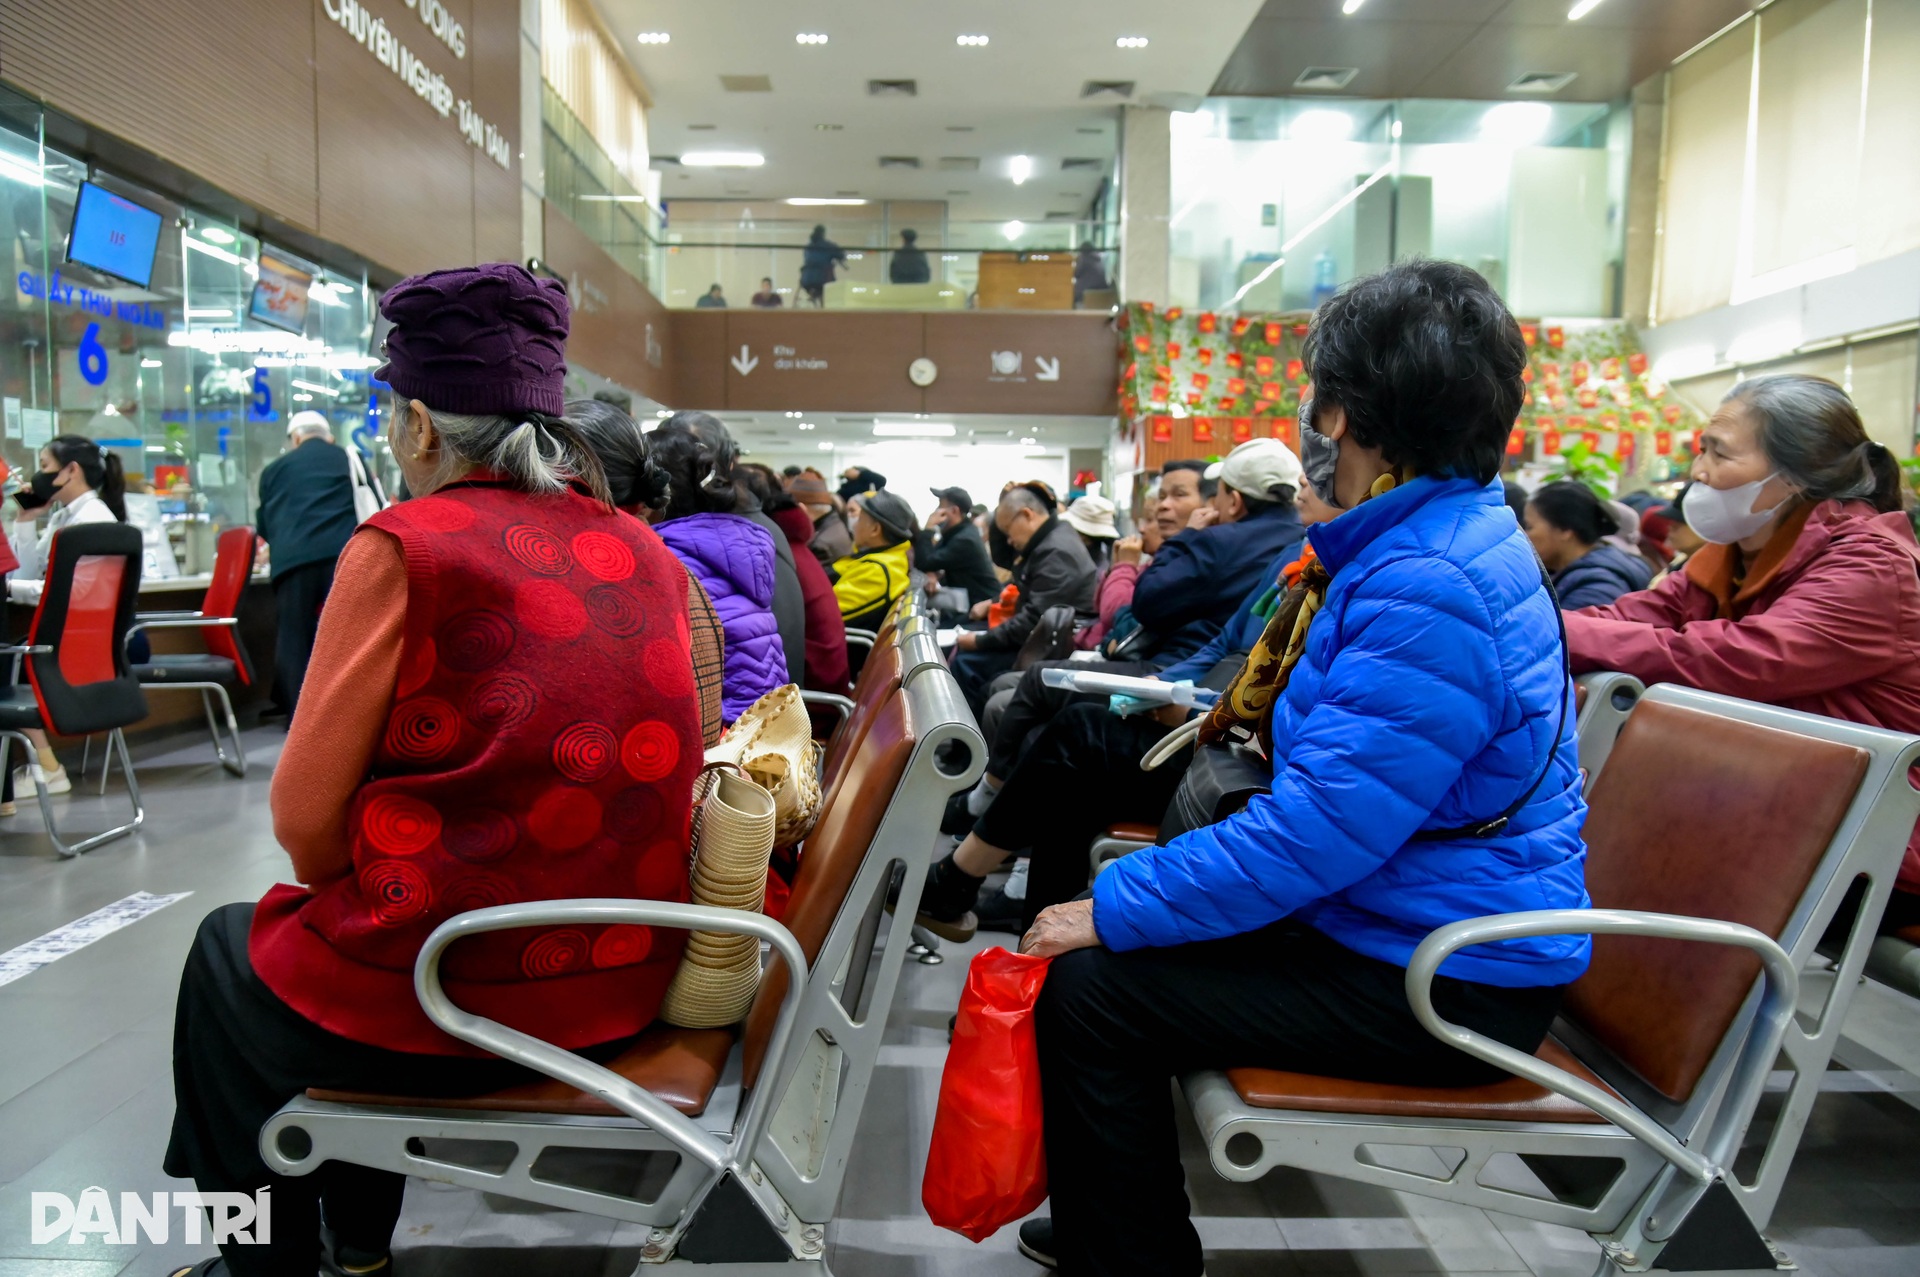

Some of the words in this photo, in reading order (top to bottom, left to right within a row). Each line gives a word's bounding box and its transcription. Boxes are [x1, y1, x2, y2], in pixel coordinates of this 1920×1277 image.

[485, 124, 510, 169] TÂM
[80, 288, 111, 317] THU
[78, 322, 108, 386] 6
[253, 366, 272, 416] 5
